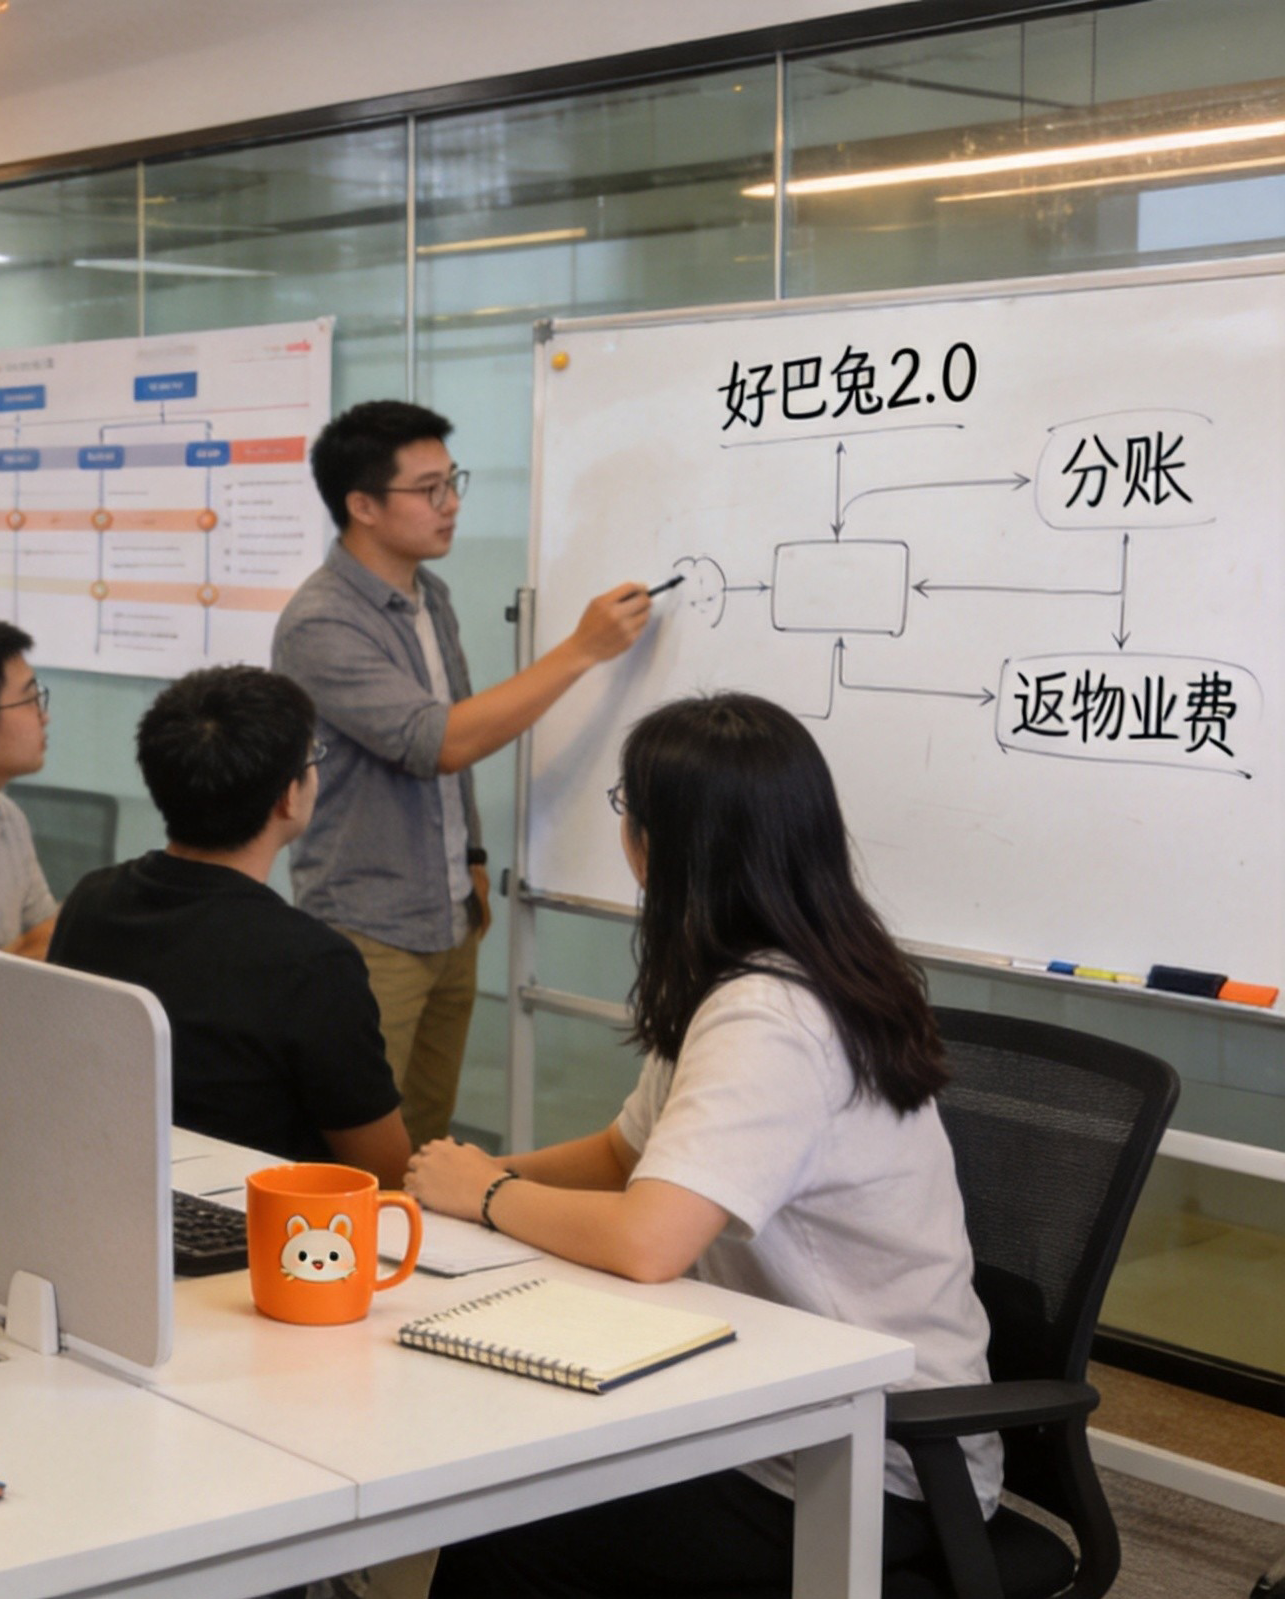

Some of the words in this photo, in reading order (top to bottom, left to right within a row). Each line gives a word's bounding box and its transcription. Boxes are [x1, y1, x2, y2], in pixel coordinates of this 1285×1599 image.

[718, 342, 977, 430] 好巴兔2.0
[1062, 431, 1193, 507] 分账
[1012, 669, 1237, 756] 返物业费
